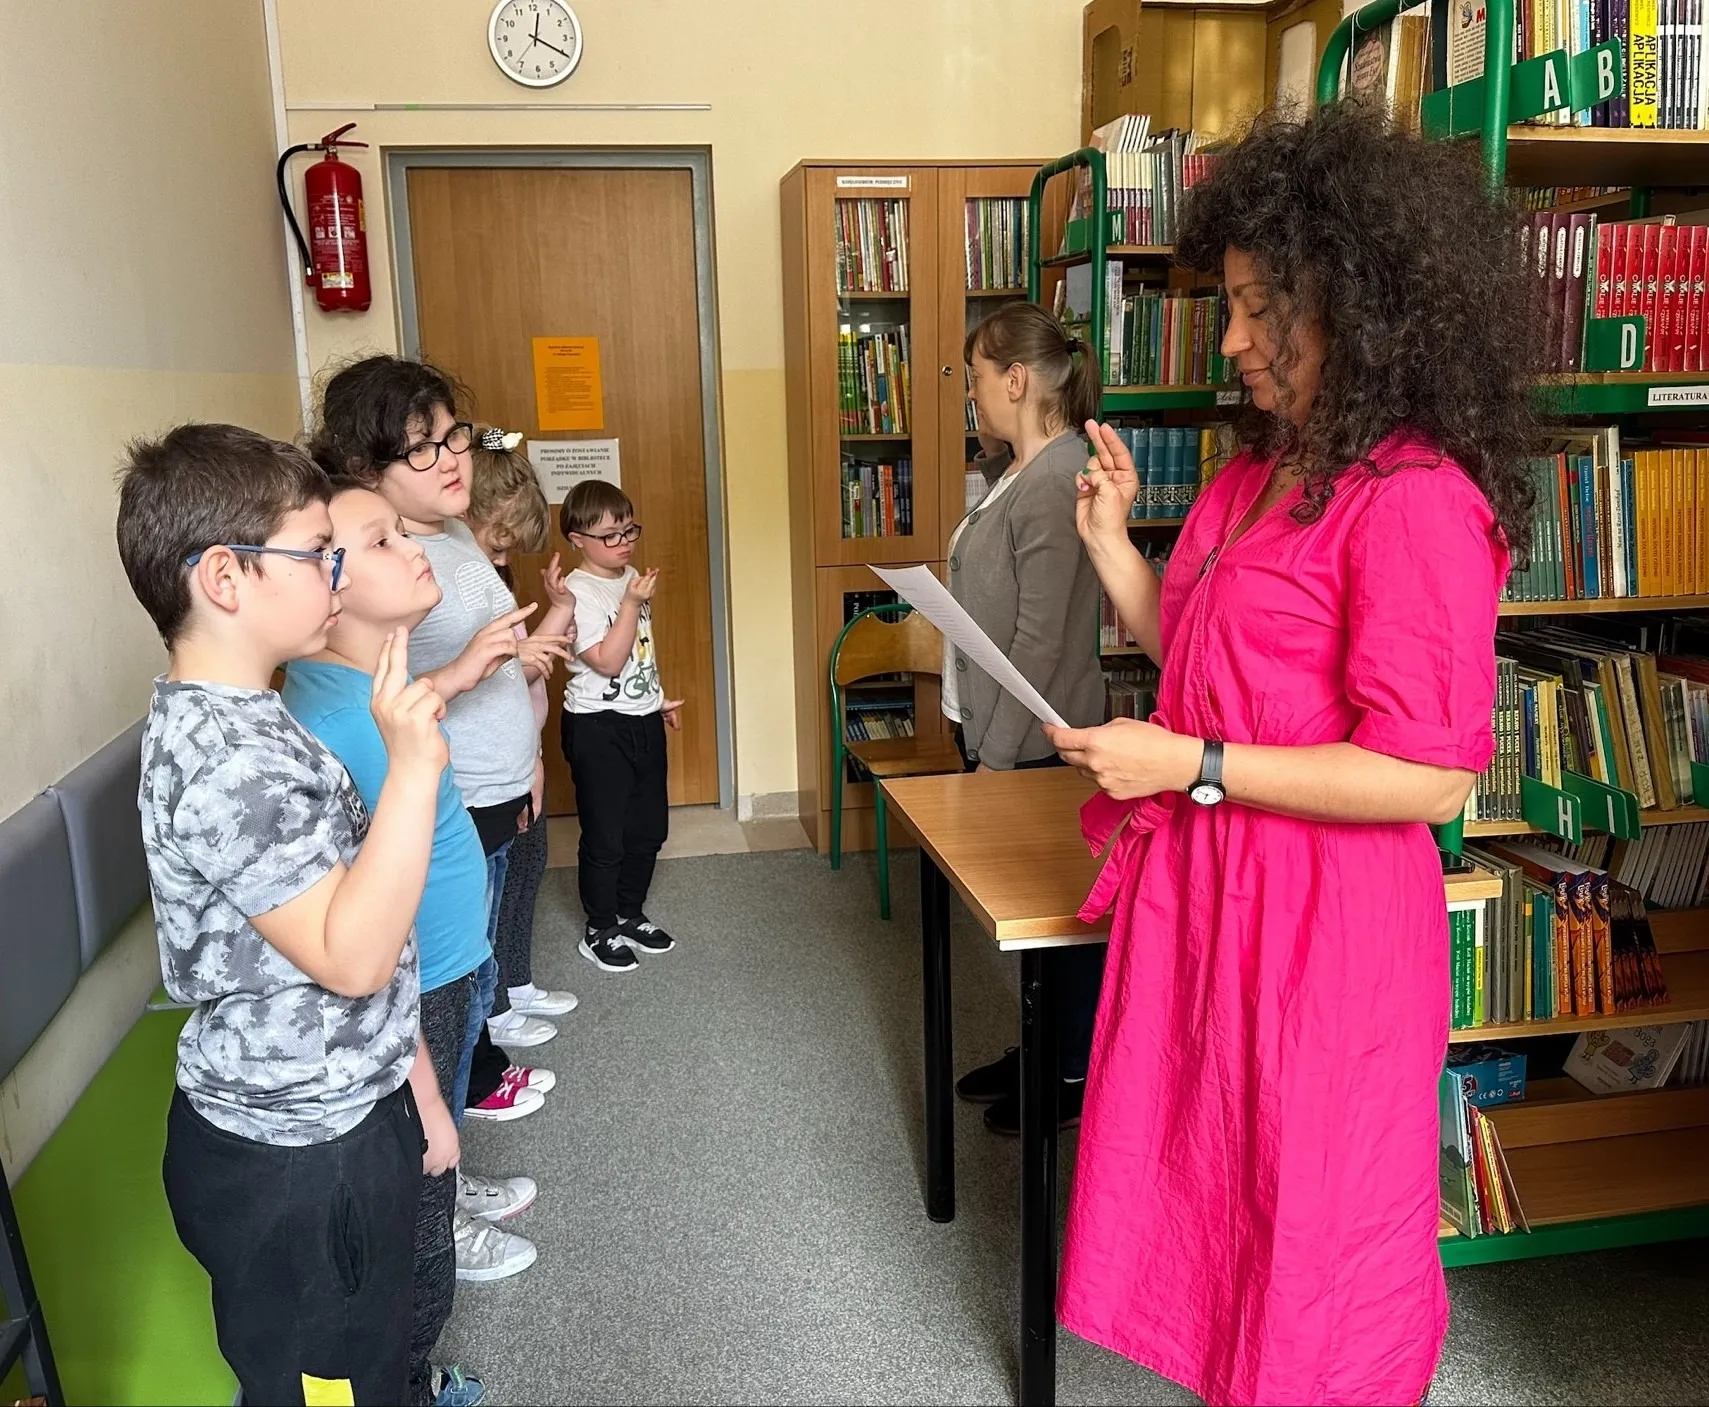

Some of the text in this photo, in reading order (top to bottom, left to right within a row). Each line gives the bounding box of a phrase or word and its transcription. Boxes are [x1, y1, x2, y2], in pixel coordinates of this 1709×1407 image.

[528, 4, 538, 12] 12
[546, 8, 550, 16] 1
[505, 20, 515, 28] 10
[557, 19, 563, 27] 2
[563, 34, 568, 42] 3
[507, 49, 513, 57] 8
[535, 65, 541, 73] 6
[1597, 49, 1614, 99] B
[1633, 34, 1644, 105] APLIKACJA
[1645, 35, 1656, 105] APLIKACJA
[1543, 59, 1562, 110] A
[1112, 213, 1122, 242] M
[1620, 323, 1637, 368] D
[1652, 392, 1708, 402] LITERATURA
[1557, 796, 1573, 840] H
[1606, 795, 1616, 834] I
[1634, 1027, 1657, 1047] Boga
